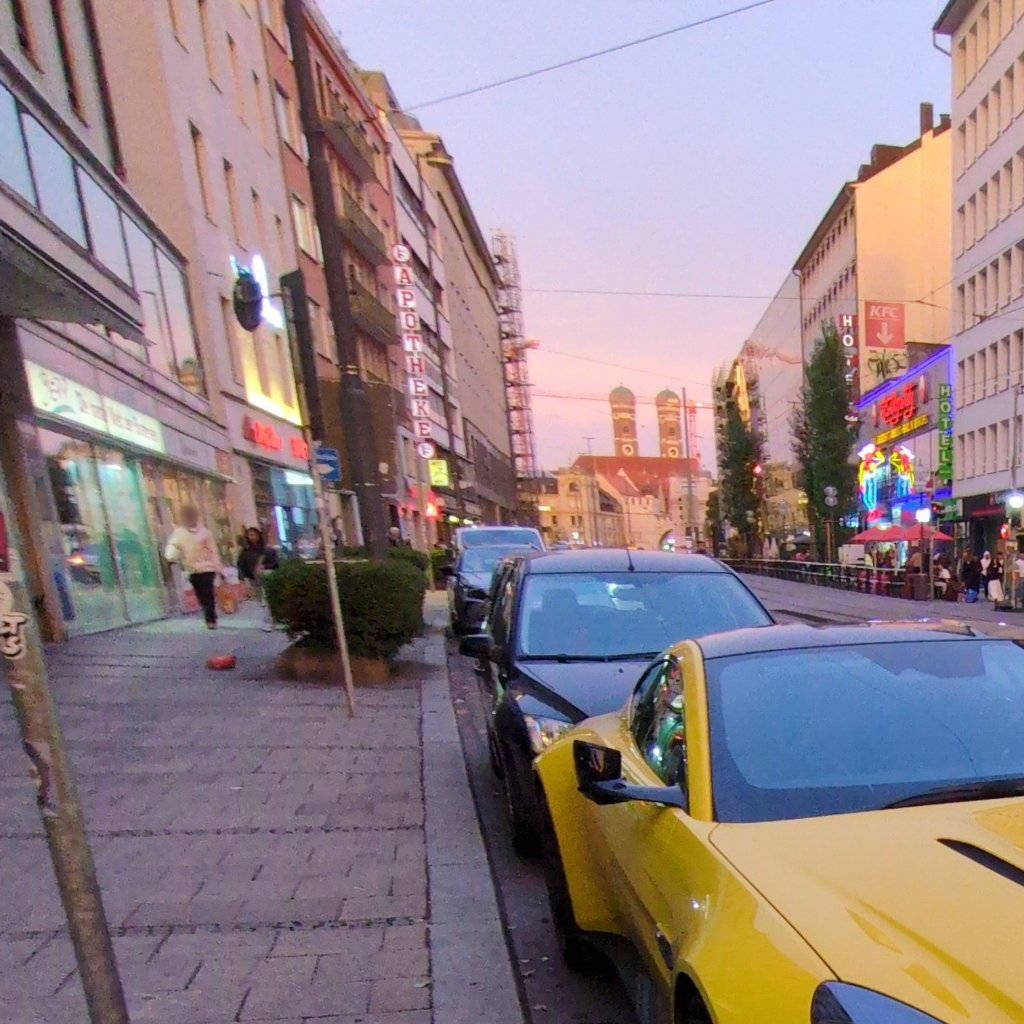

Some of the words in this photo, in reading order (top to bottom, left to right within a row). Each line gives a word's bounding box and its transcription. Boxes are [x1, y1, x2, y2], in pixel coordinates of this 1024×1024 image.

[869, 304, 899, 318] KFC
[400, 268, 431, 438] APOTHEKE
[940, 384, 952, 462] HOTEL
